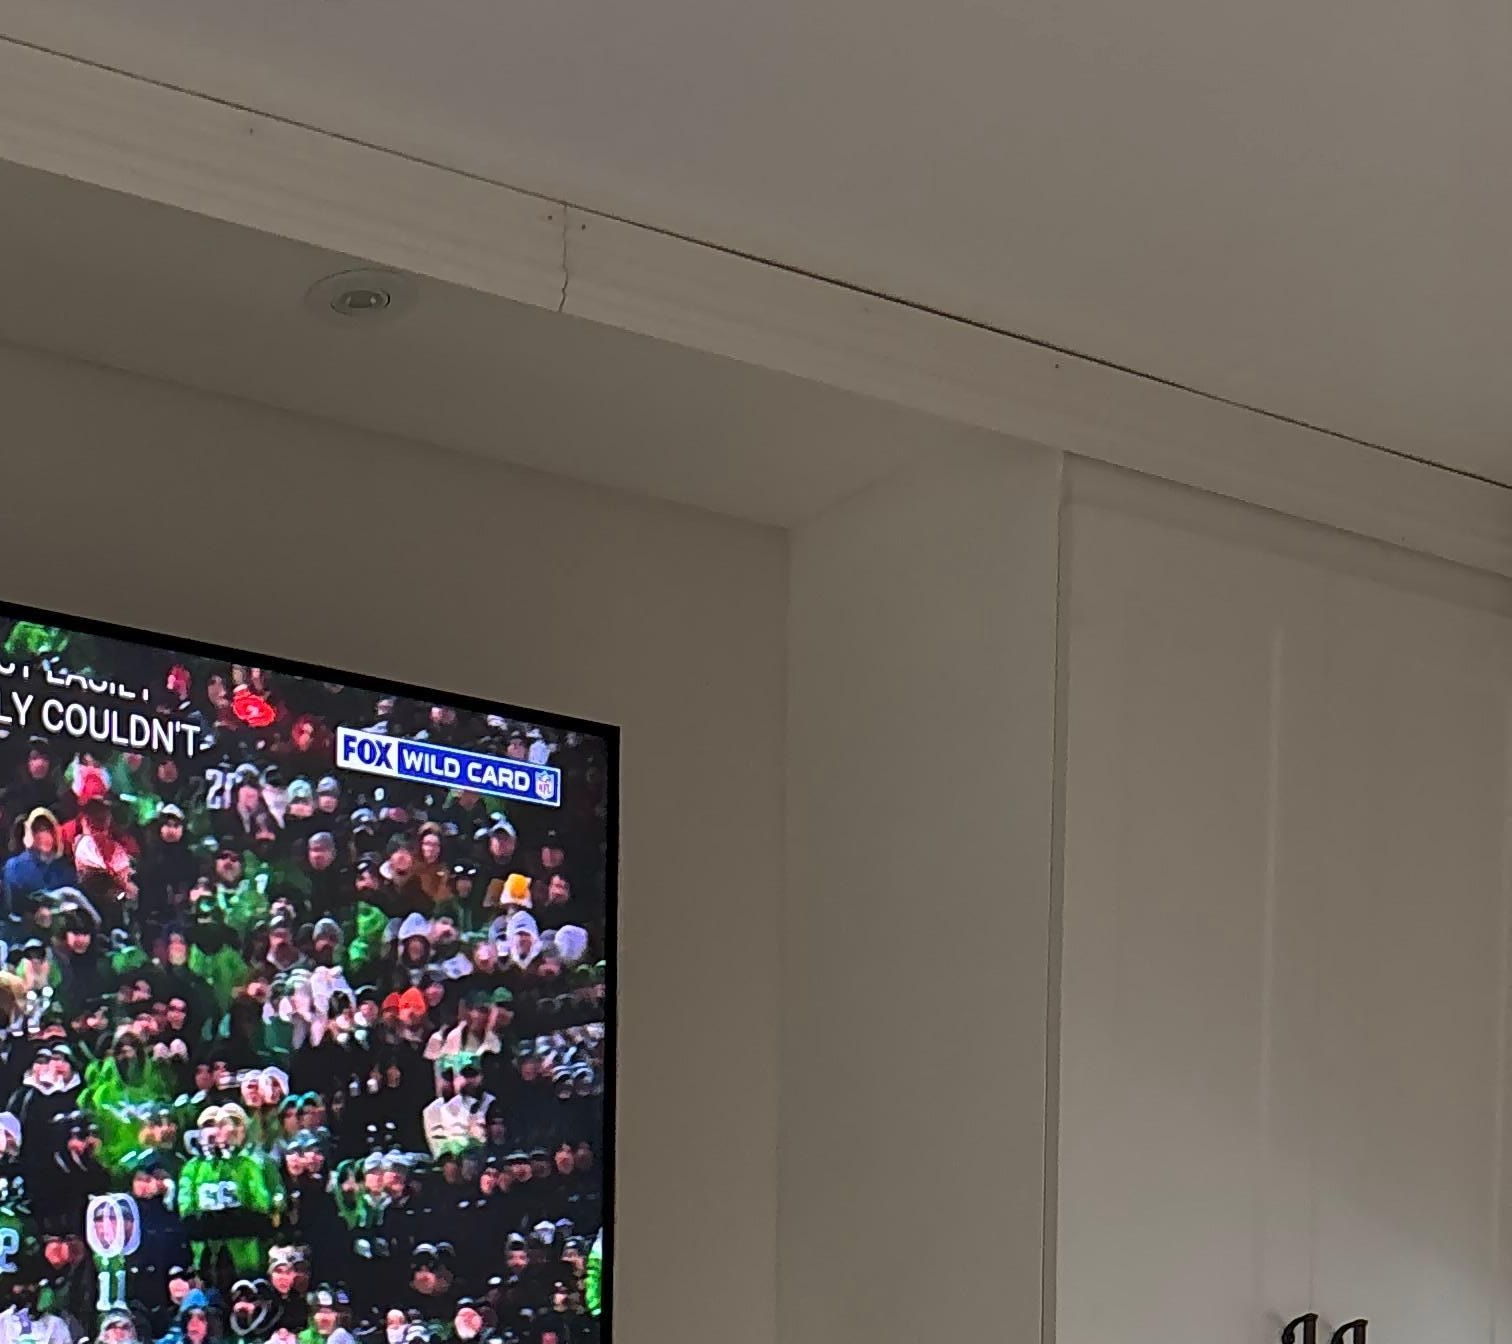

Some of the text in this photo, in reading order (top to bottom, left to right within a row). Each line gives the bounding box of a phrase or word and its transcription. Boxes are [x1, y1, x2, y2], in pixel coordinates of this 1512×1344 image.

[41, 698, 201, 757] COULDN'T
[343, 734, 531, 792] FOX WILD CARD
